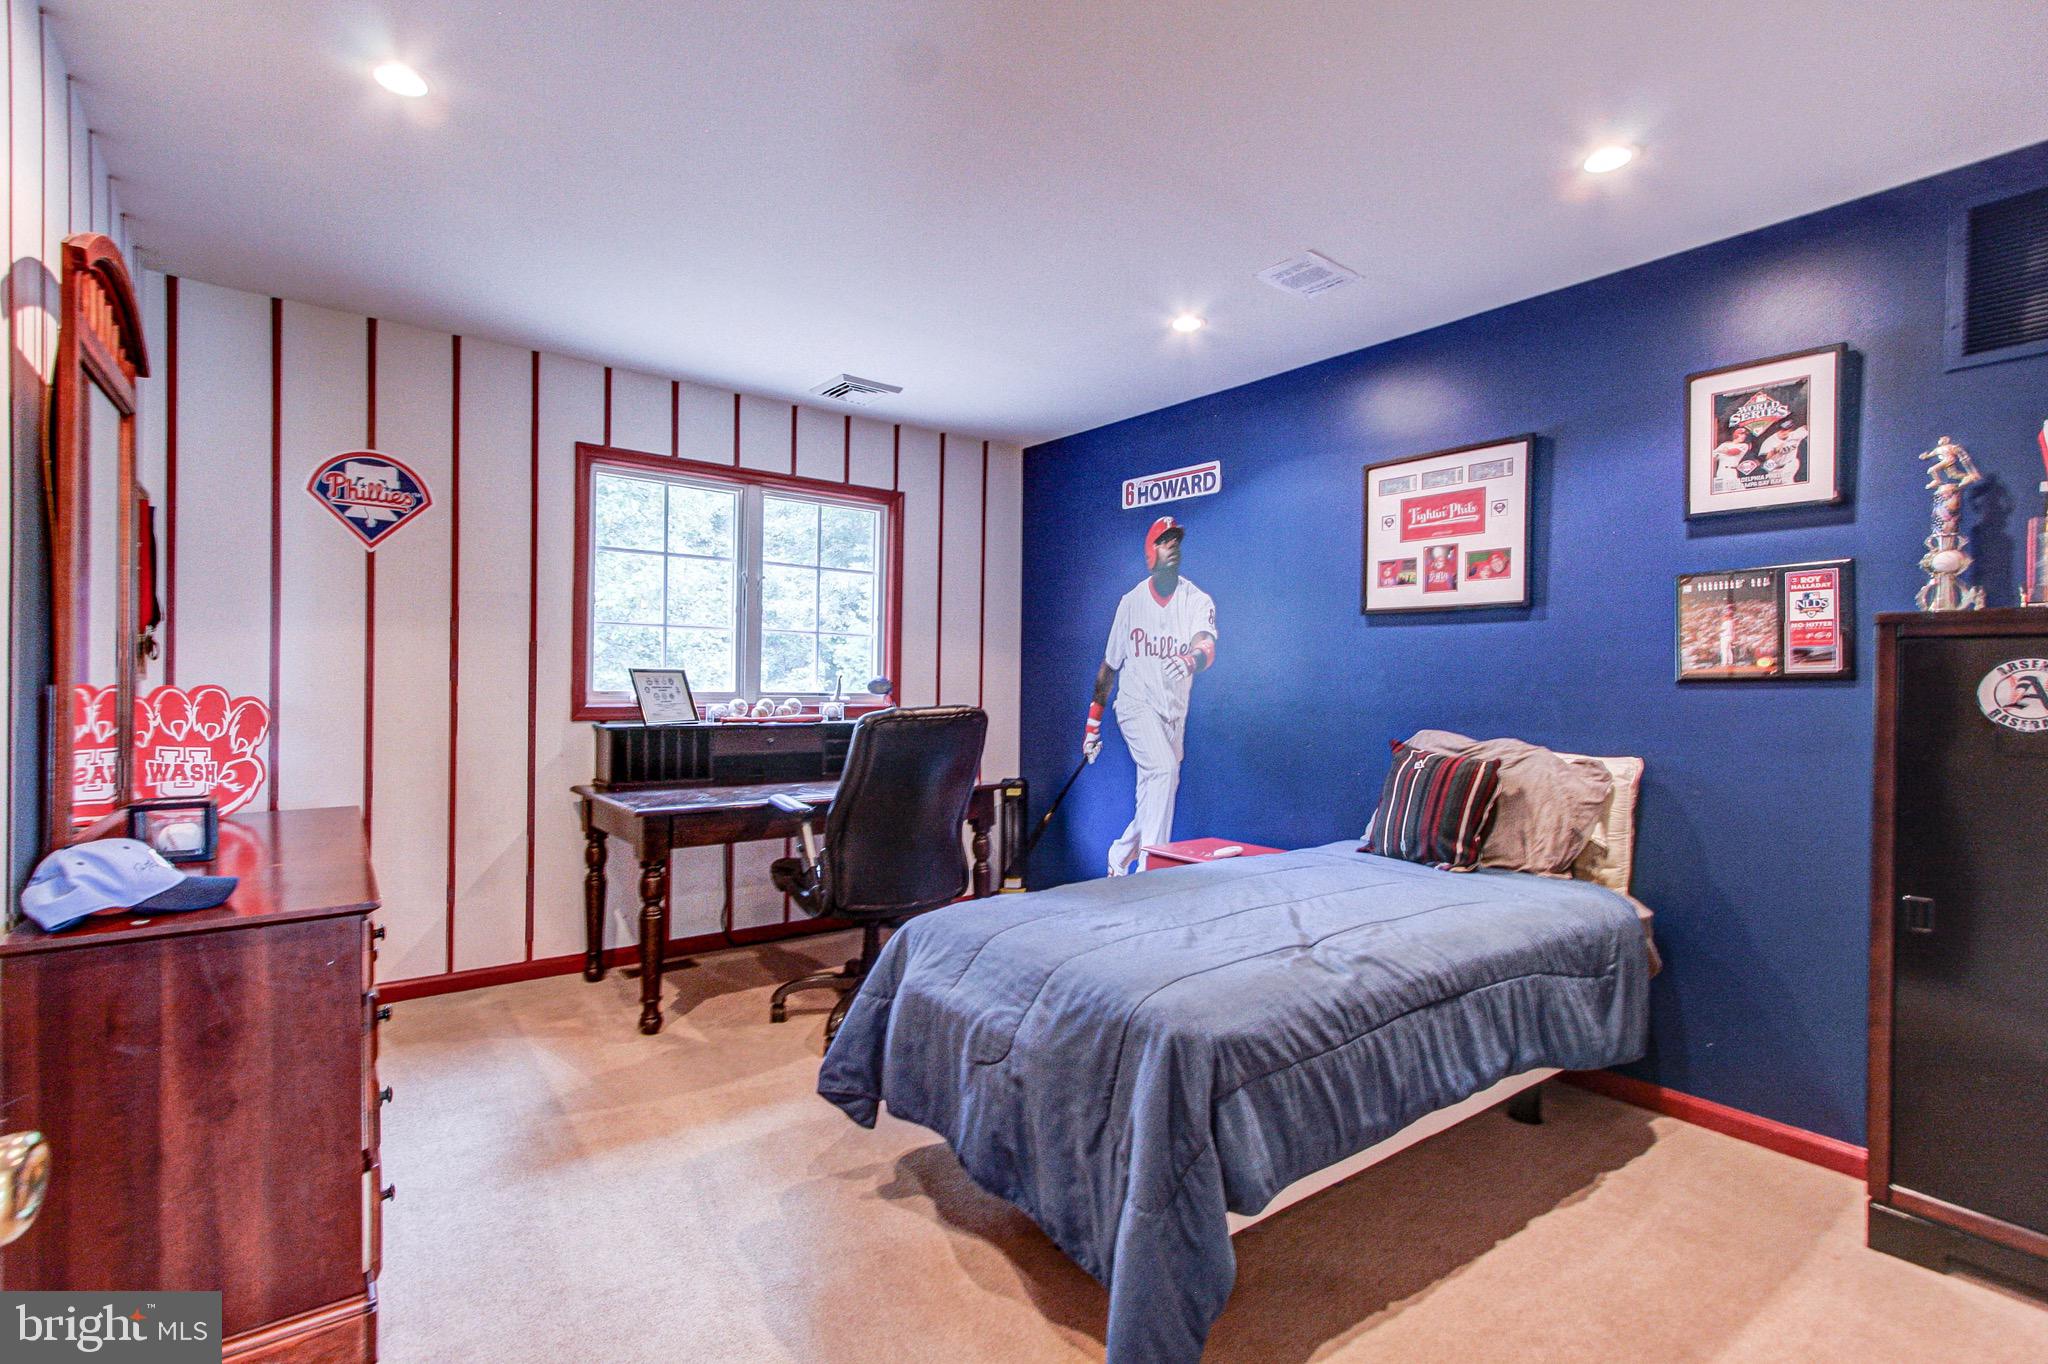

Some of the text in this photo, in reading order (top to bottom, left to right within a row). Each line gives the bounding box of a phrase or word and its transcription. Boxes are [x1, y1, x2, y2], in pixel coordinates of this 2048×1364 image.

[1729, 405, 1791, 427] SERIES
[1737, 400, 1780, 414] WORLD
[322, 471, 415, 506] Phillies
[1125, 471, 1217, 506] 6 HOWARD
[1449, 502, 1478, 519] Phils
[1791, 582, 1832, 590] HALLADAY
[1800, 574, 1822, 584] ROY
[1796, 598, 1829, 609] NLDS
[1130, 627, 1191, 660] Phillie
[146, 762, 216, 783] WASH
